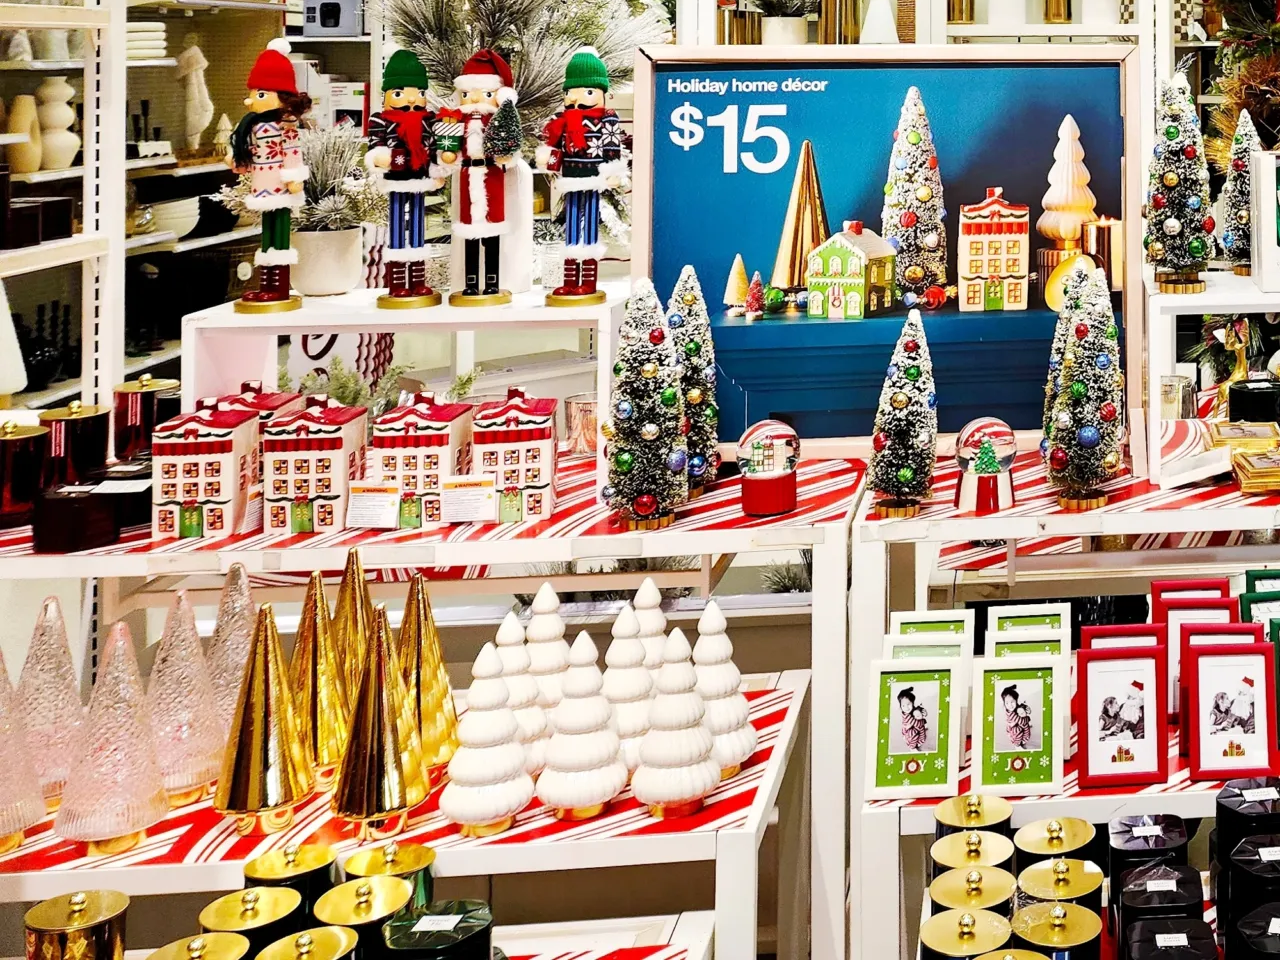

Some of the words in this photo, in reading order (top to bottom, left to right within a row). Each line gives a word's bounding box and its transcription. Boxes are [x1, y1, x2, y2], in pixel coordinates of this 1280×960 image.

[667, 78, 729, 96] Holiday
[732, 78, 778, 92] home
[781, 77, 828, 92] décor
[669, 101, 791, 174] $15
[899, 758, 927, 775] JOY
[1005, 756, 1032, 772] JOY
